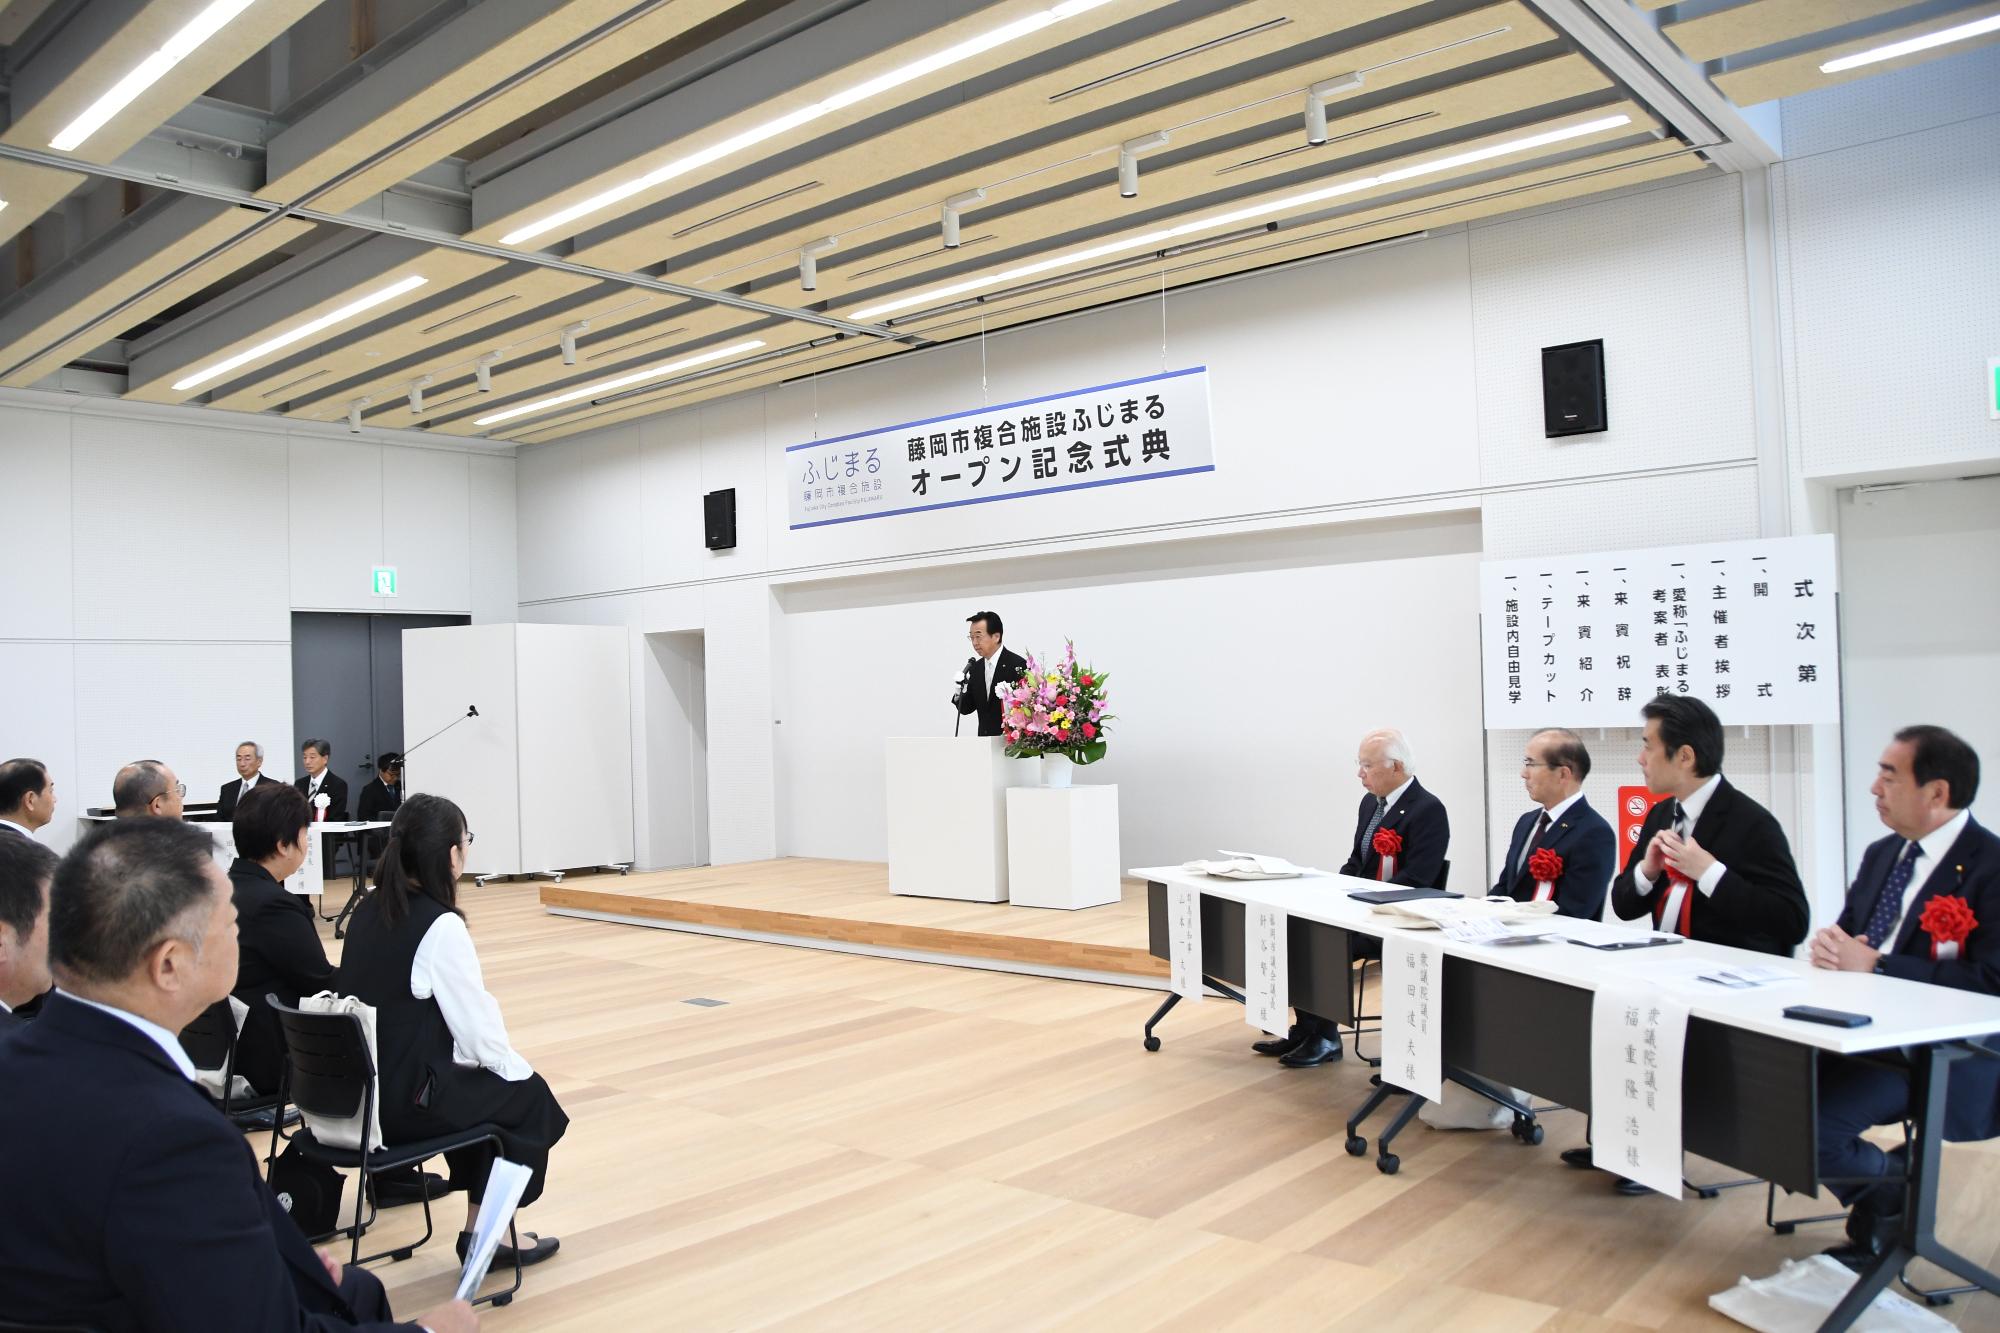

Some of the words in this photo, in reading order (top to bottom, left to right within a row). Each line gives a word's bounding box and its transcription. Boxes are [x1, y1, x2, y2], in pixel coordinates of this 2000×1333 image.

[803, 448, 881, 485] ふじまる
[908, 394, 1166, 462] 藤岡市複合施設ふじまる
[911, 428, 1171, 496] オープン記念式典
[1504, 575, 1522, 705] 一、施設内自由見学
[1539, 572, 1557, 703] 一、テープカット
[1576, 570, 1594, 703] 一、来賓紹介
[1613, 567, 1632, 702] 一、来賓祝辞
[1710, 559, 1732, 699] 一、主催者挨拶
[1793, 578, 1818, 684] 式次第
[1624, 1005, 1641, 1168] 福重隆浩様
[1642, 1007, 1661, 1112] 衆議院議員
